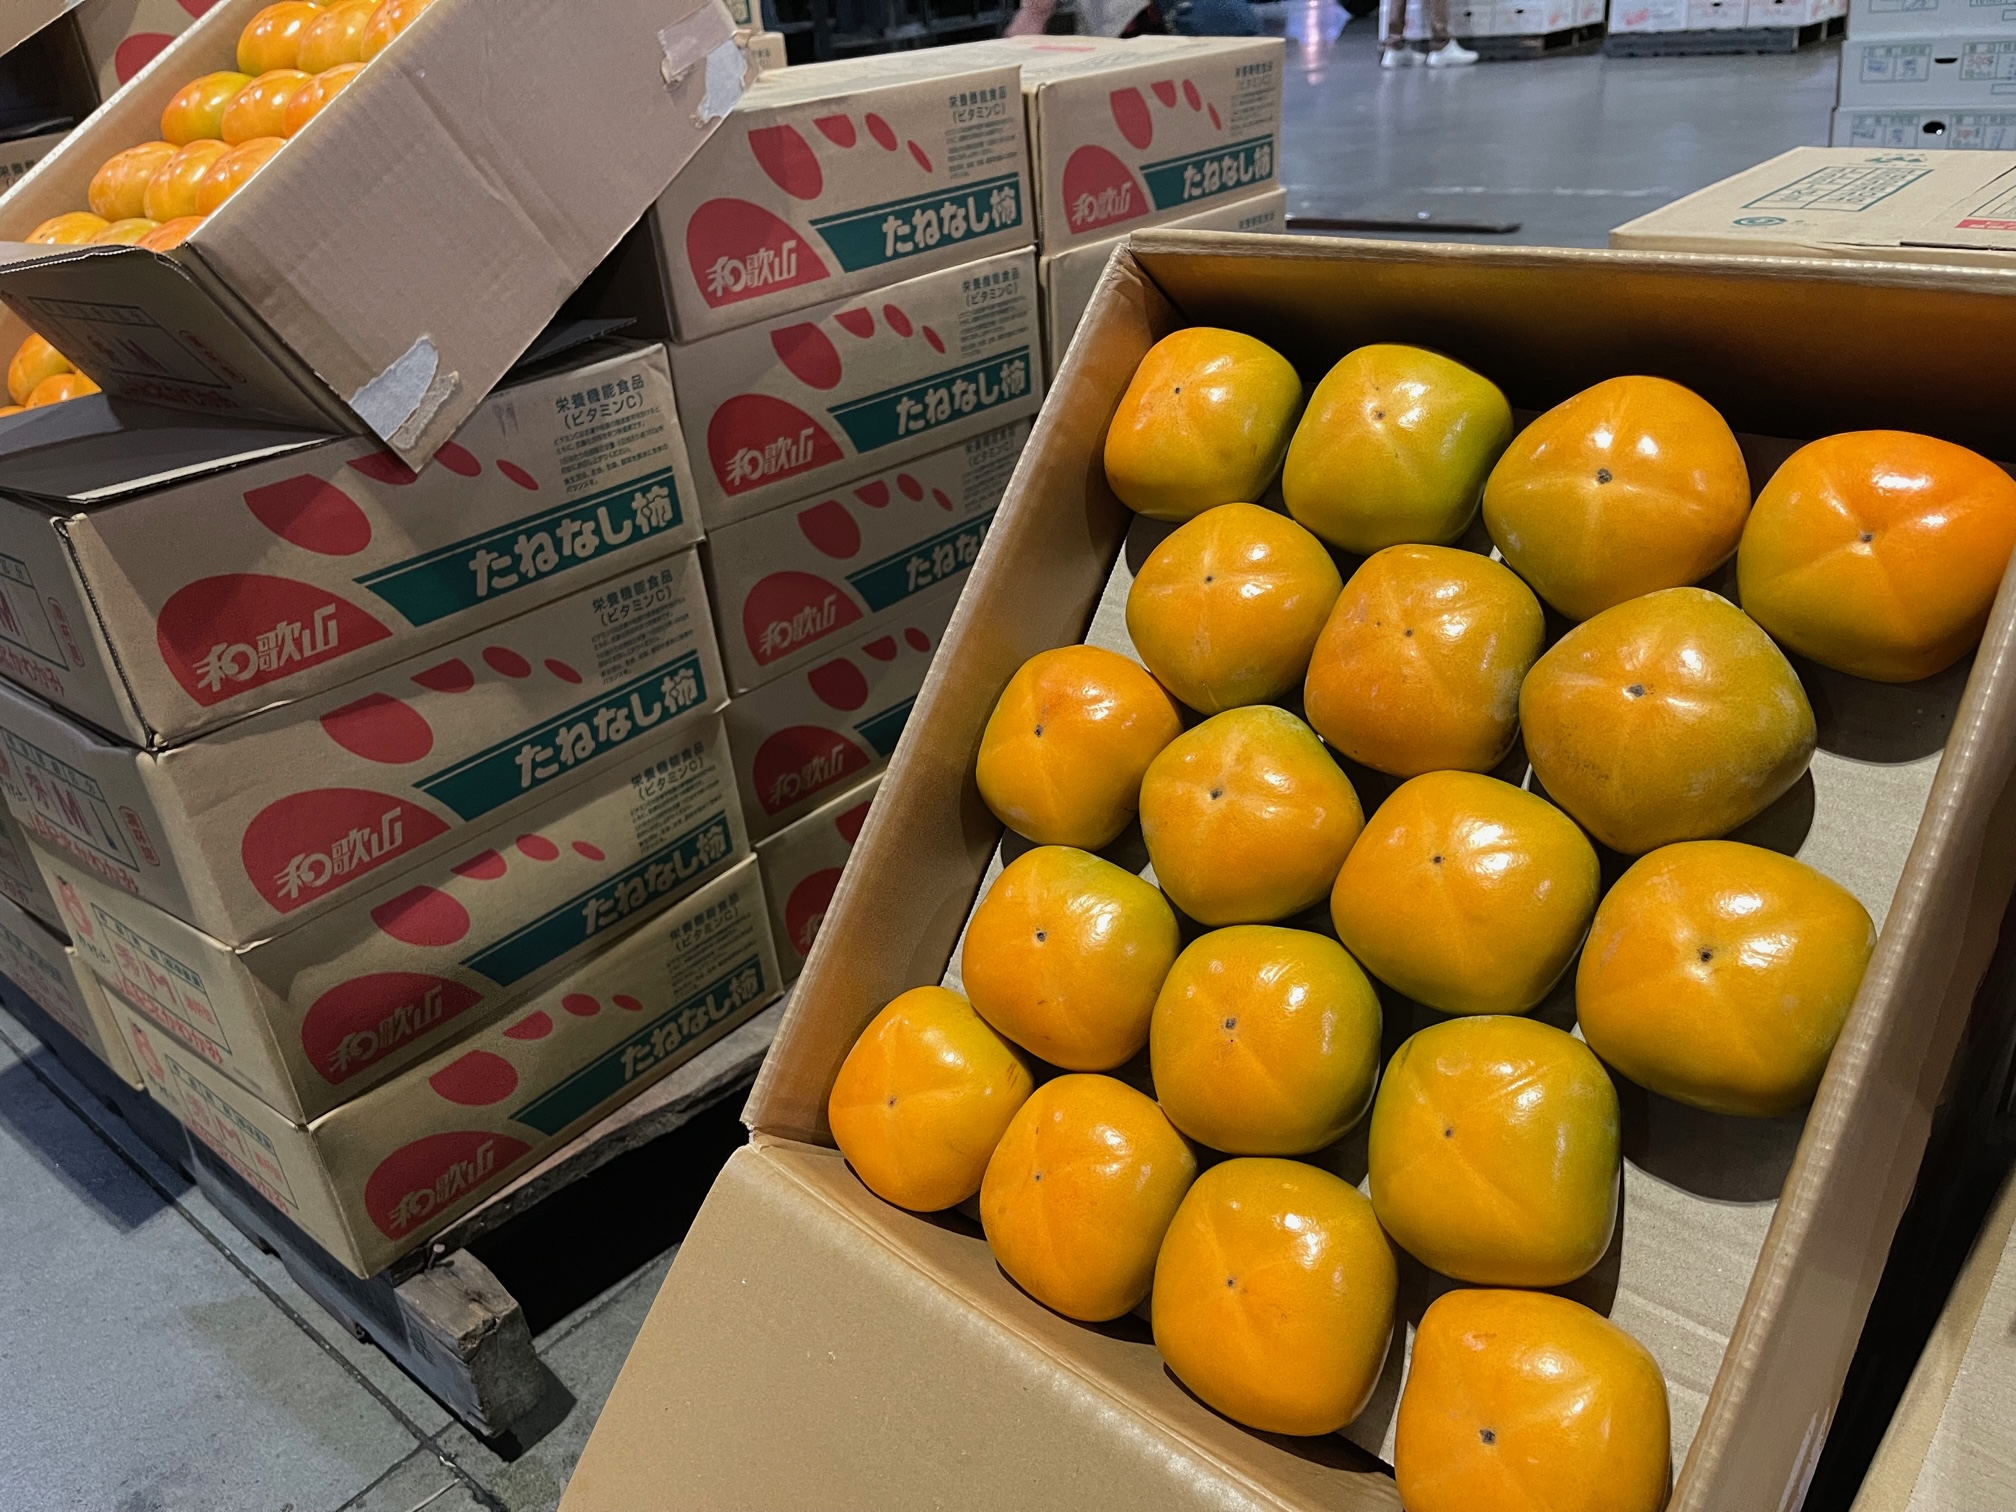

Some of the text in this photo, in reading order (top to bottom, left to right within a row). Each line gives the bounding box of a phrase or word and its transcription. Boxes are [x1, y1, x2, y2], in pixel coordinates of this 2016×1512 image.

[1072, 180, 1133, 226] 和歌山
[1183, 145, 1271, 200] たねなし柿
[882, 185, 1017, 257] たねなし柿
[705, 239, 797, 297] 和歌山
[555, 374, 644, 413] 栄養機能食品
[564, 391, 644, 430] (ビタミンC)
[896, 359, 1026, 436] たねなし柿
[725, 426, 814, 486] 和歌山
[469, 485, 673, 597] たねなし柿
[601, 585, 672, 626] (ビタミンC)
[759, 593, 837, 656] 和歌山
[193, 603, 338, 692] 和歌山
[514, 668, 698, 788] たねなし柿
[768, 742, 845, 805] 和歌山
[51, 781, 93, 836] M
[273, 806, 402, 899] 和歌山
[582, 824, 727, 935] たねなし柿
[143, 961, 177, 1005] M
[327, 984, 442, 1072] 和歌山
[621, 967, 758, 1081] たねなし柿
[388, 1140, 494, 1230] 和歌山
